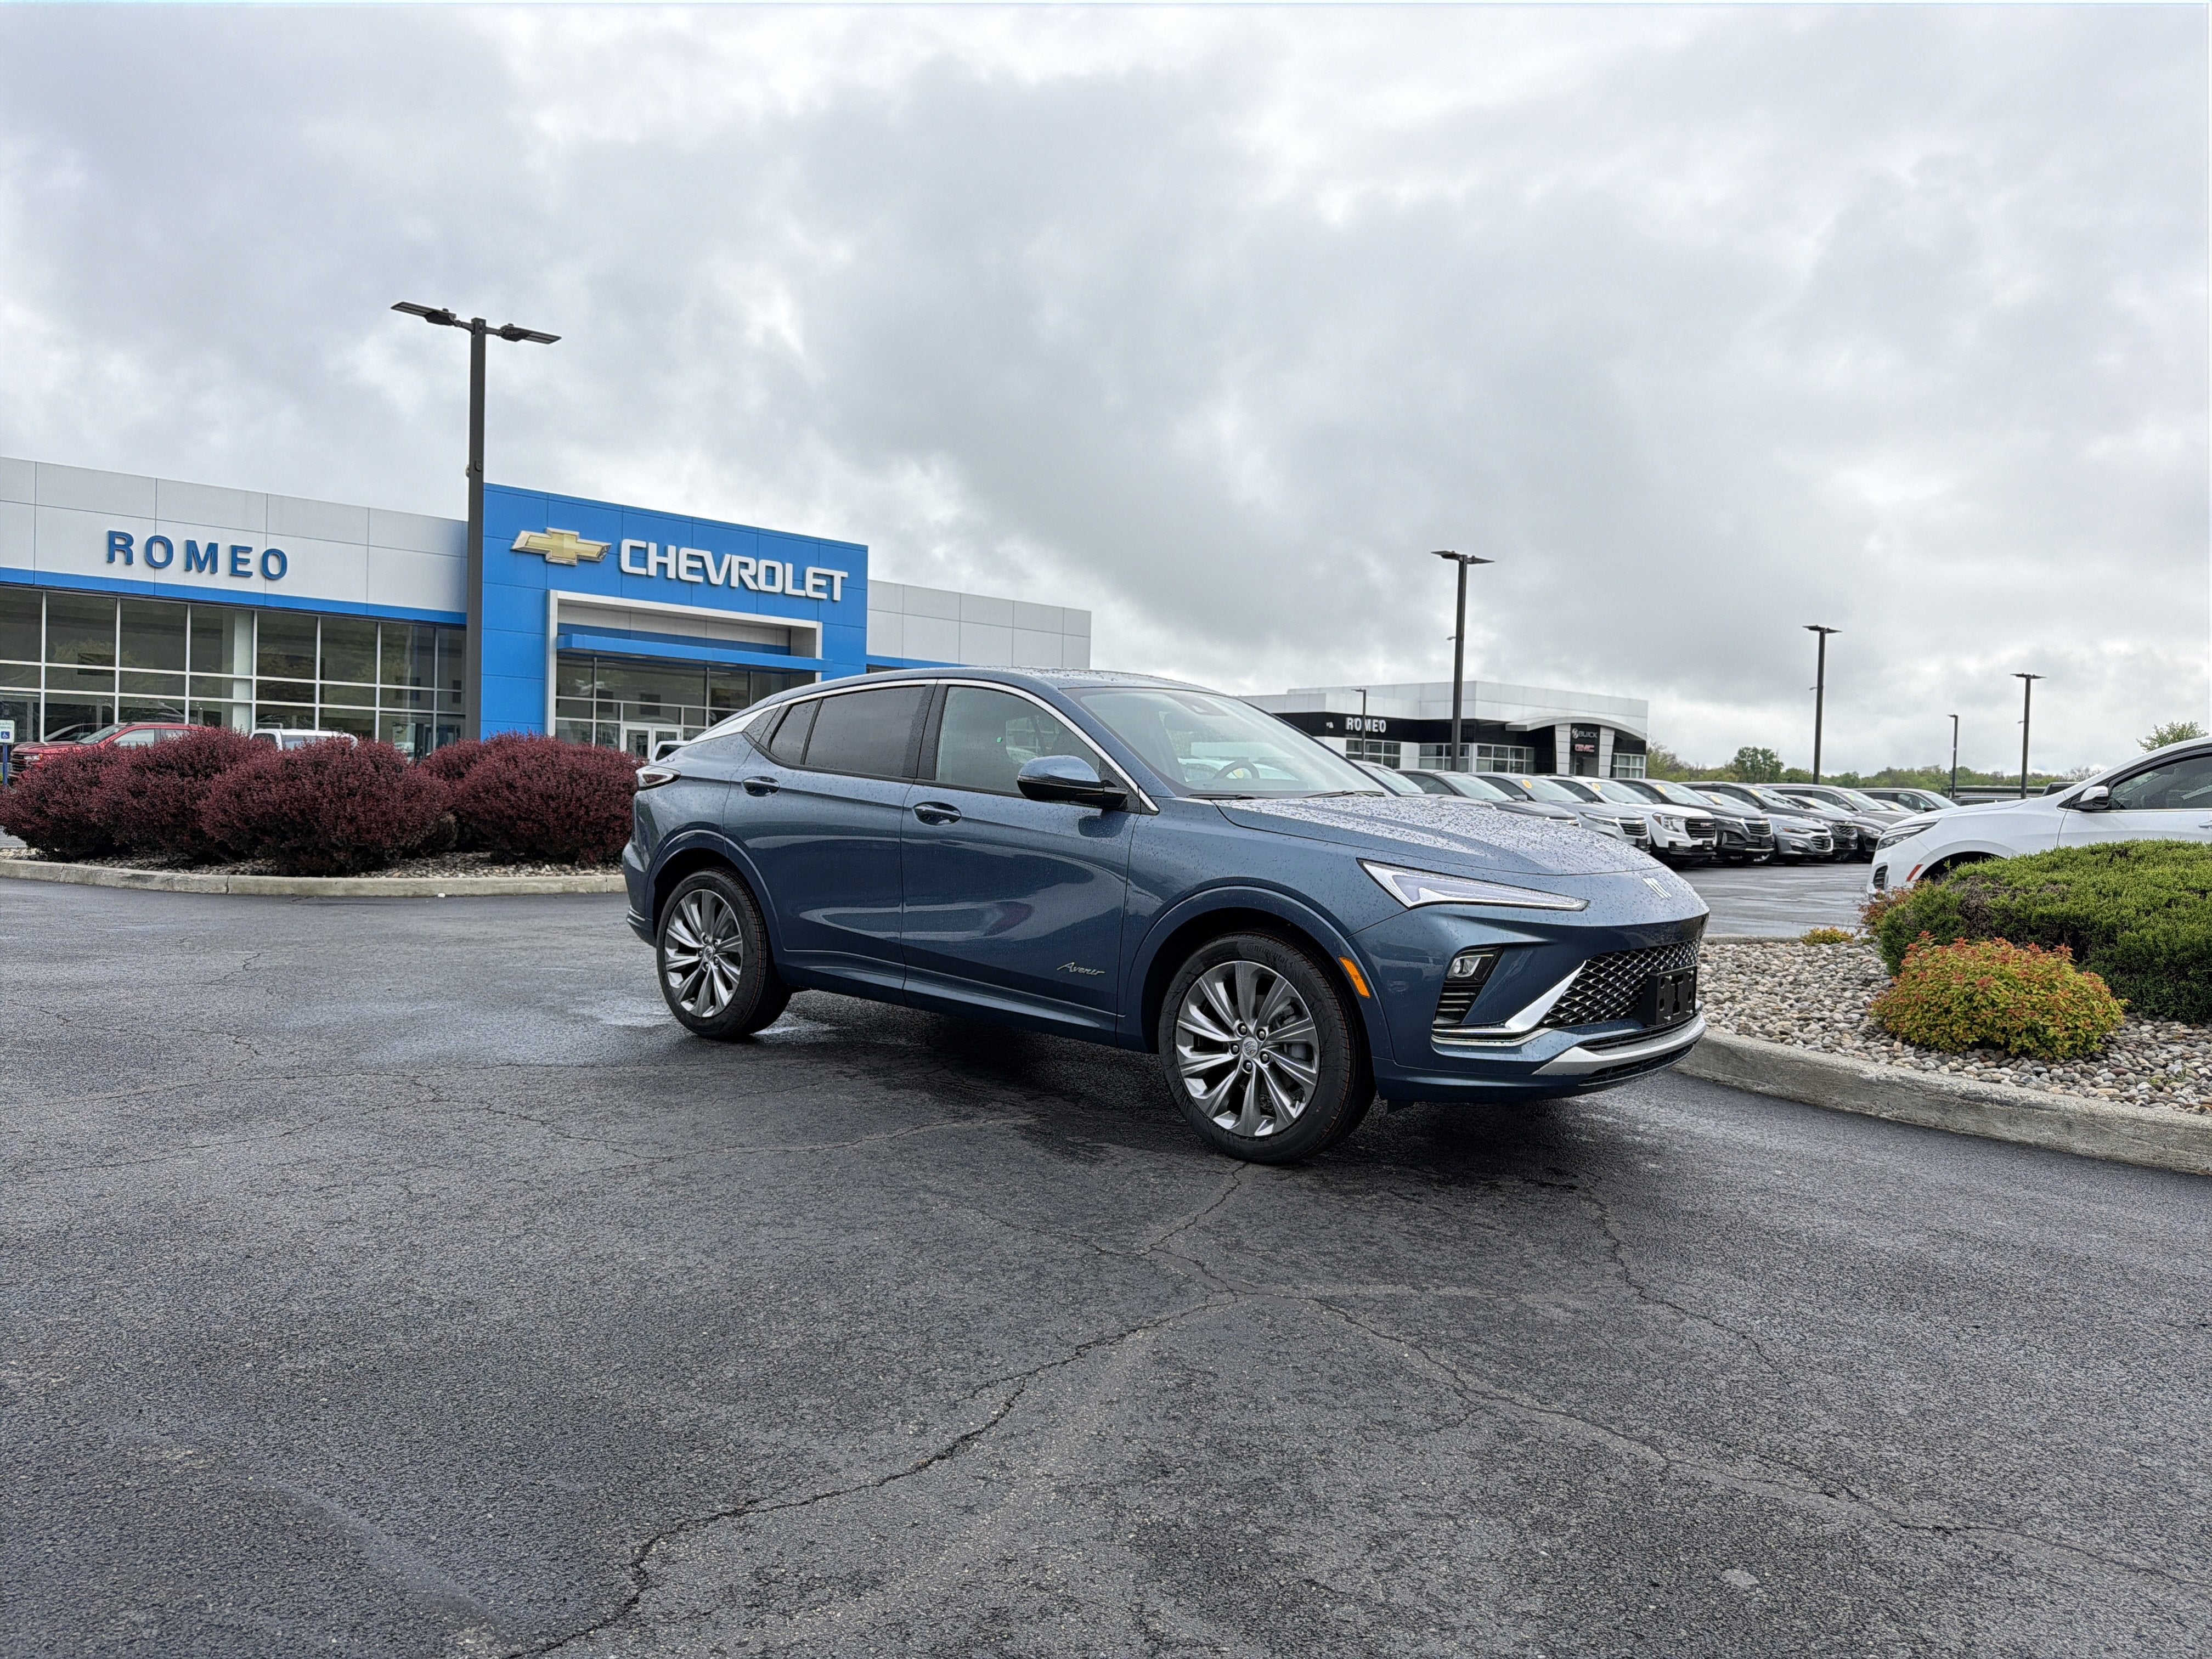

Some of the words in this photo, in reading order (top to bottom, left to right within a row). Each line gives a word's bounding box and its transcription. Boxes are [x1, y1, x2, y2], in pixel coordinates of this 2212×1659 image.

[106, 530, 288, 580] ROMEO
[620, 538, 849, 602] CHEVROLET
[1575, 743, 1595, 752] GMC
[1057, 962, 1106, 975] Avenir
